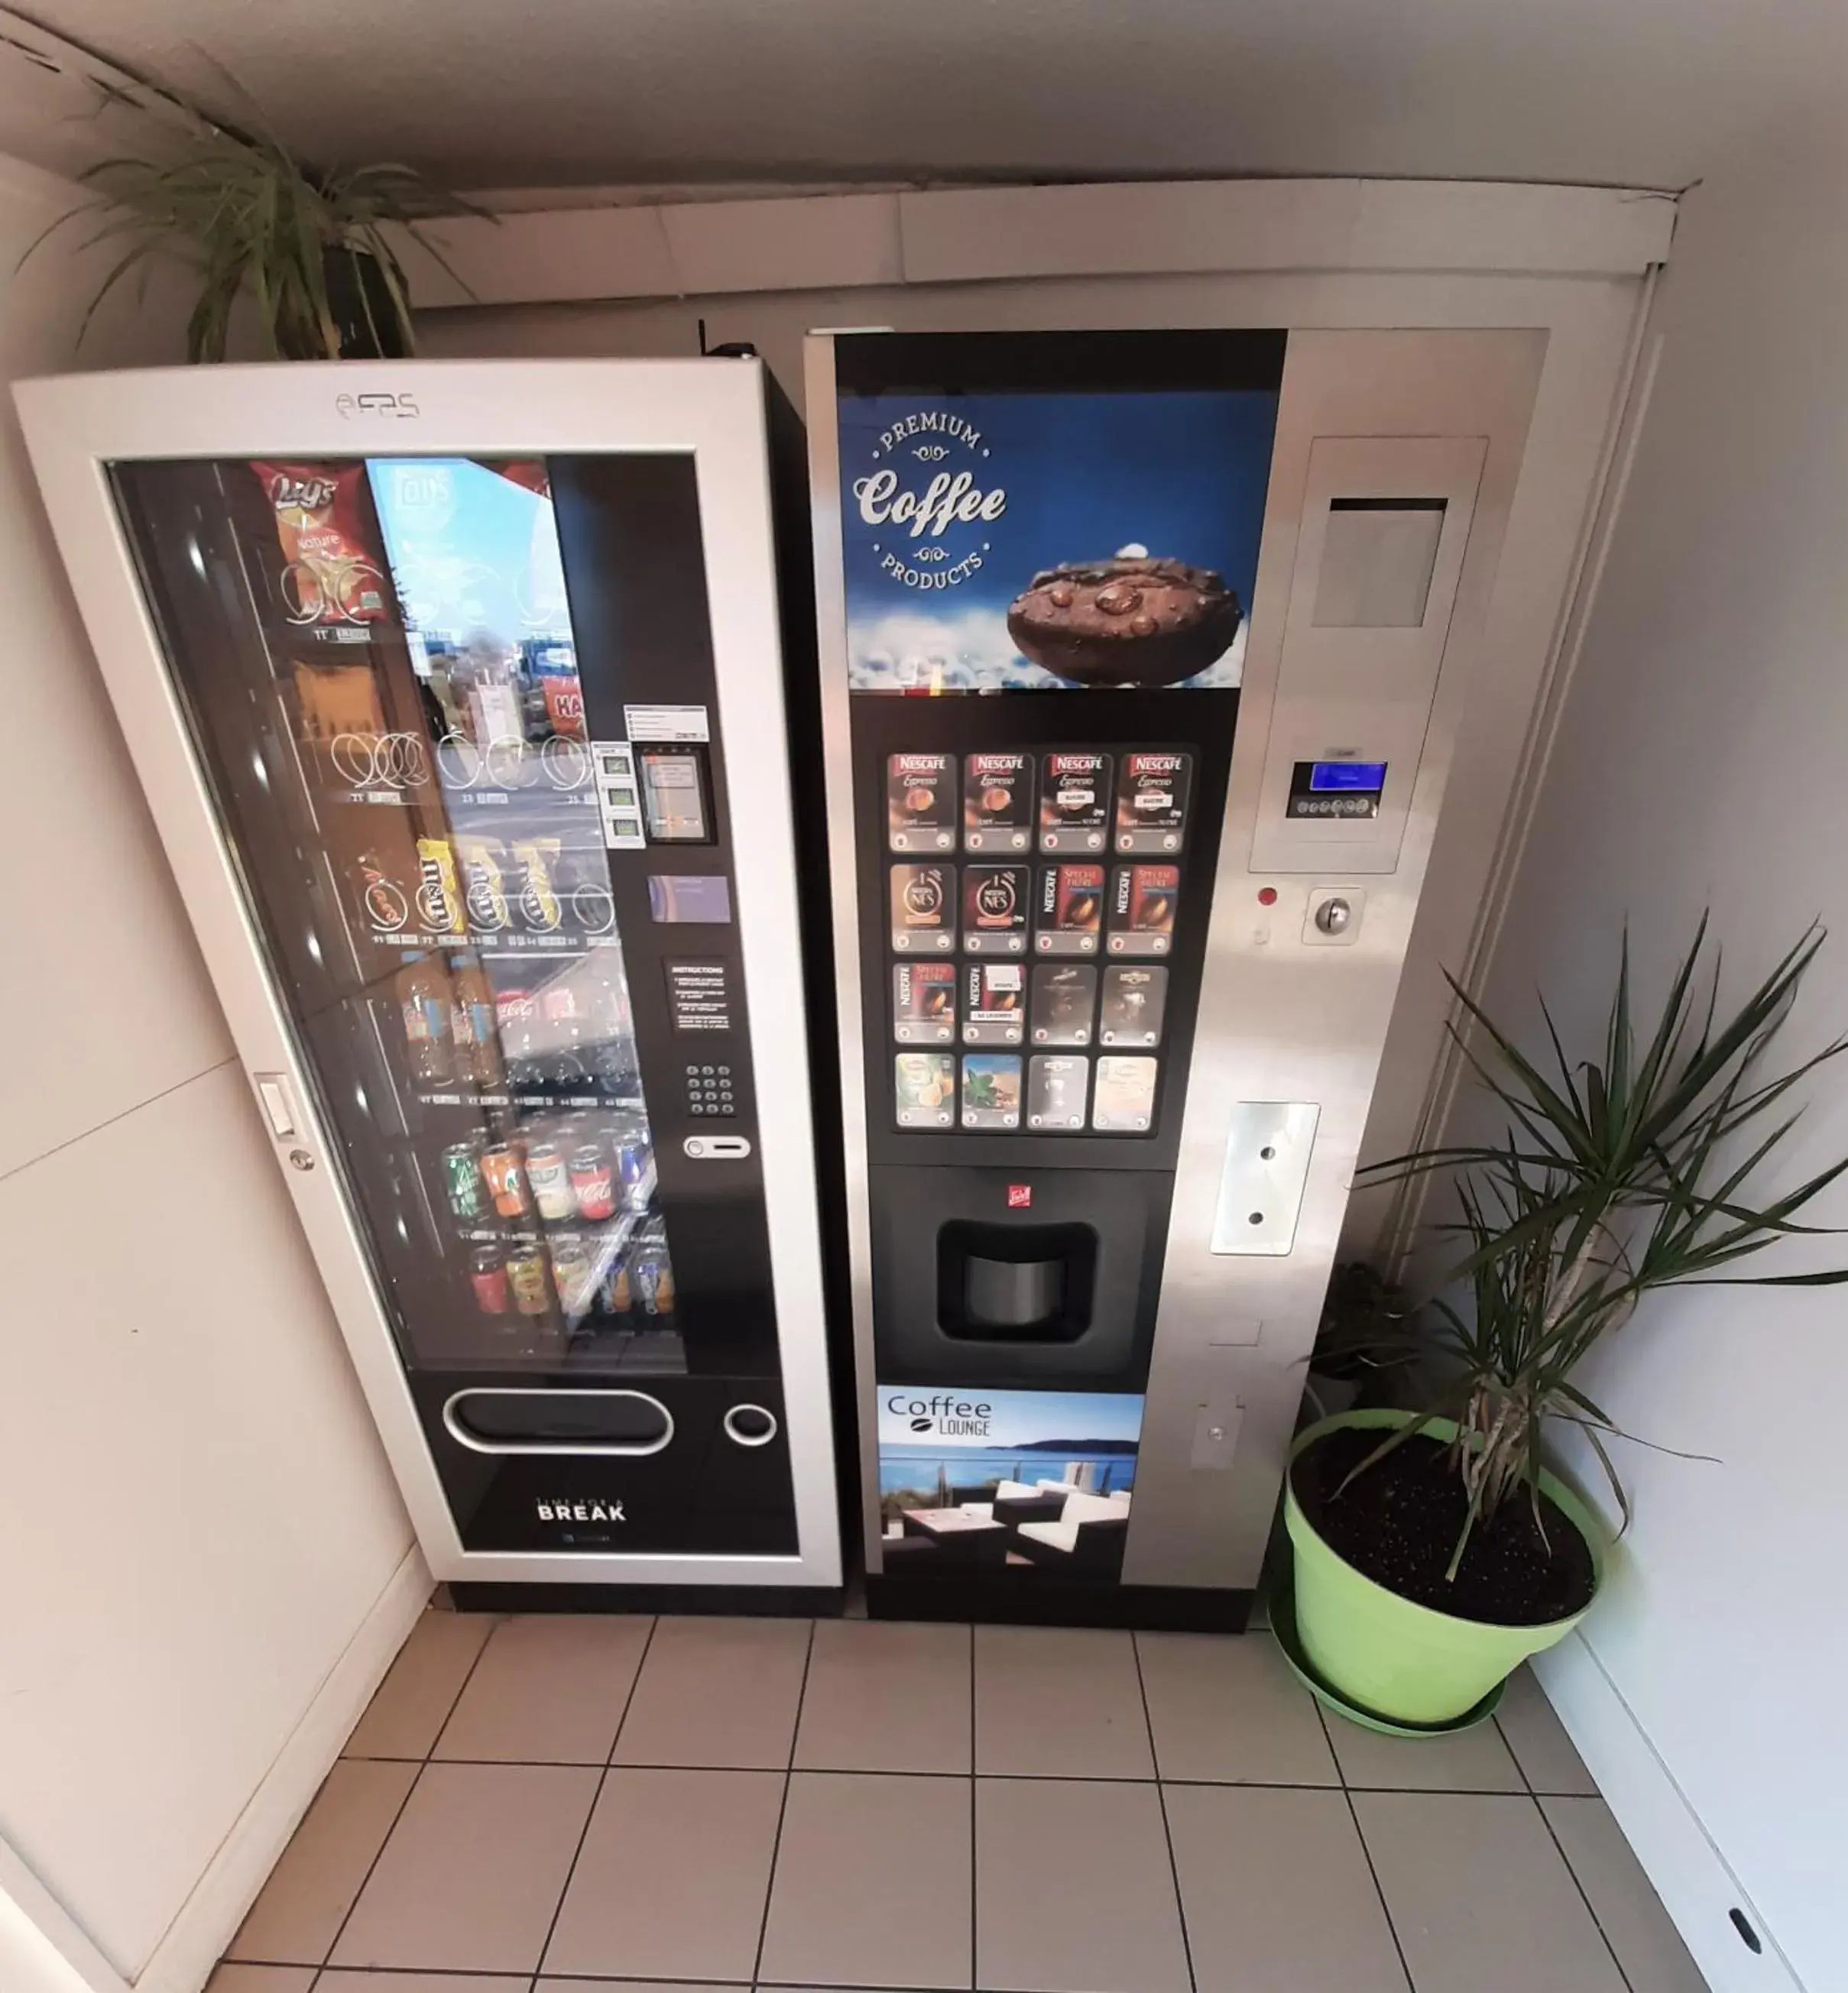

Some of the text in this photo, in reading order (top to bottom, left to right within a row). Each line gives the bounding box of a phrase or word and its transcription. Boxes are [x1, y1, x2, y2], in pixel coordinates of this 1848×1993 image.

[880, 411, 981, 452] PREMIUM
[853, 470, 1006, 537] Coffee
[880, 552, 982, 589] PRODUCTS
[887, 1395, 992, 1418] Coffee
[939, 1417, 990, 1437] LOUNGE
[537, 1505, 627, 1521] BREAK
